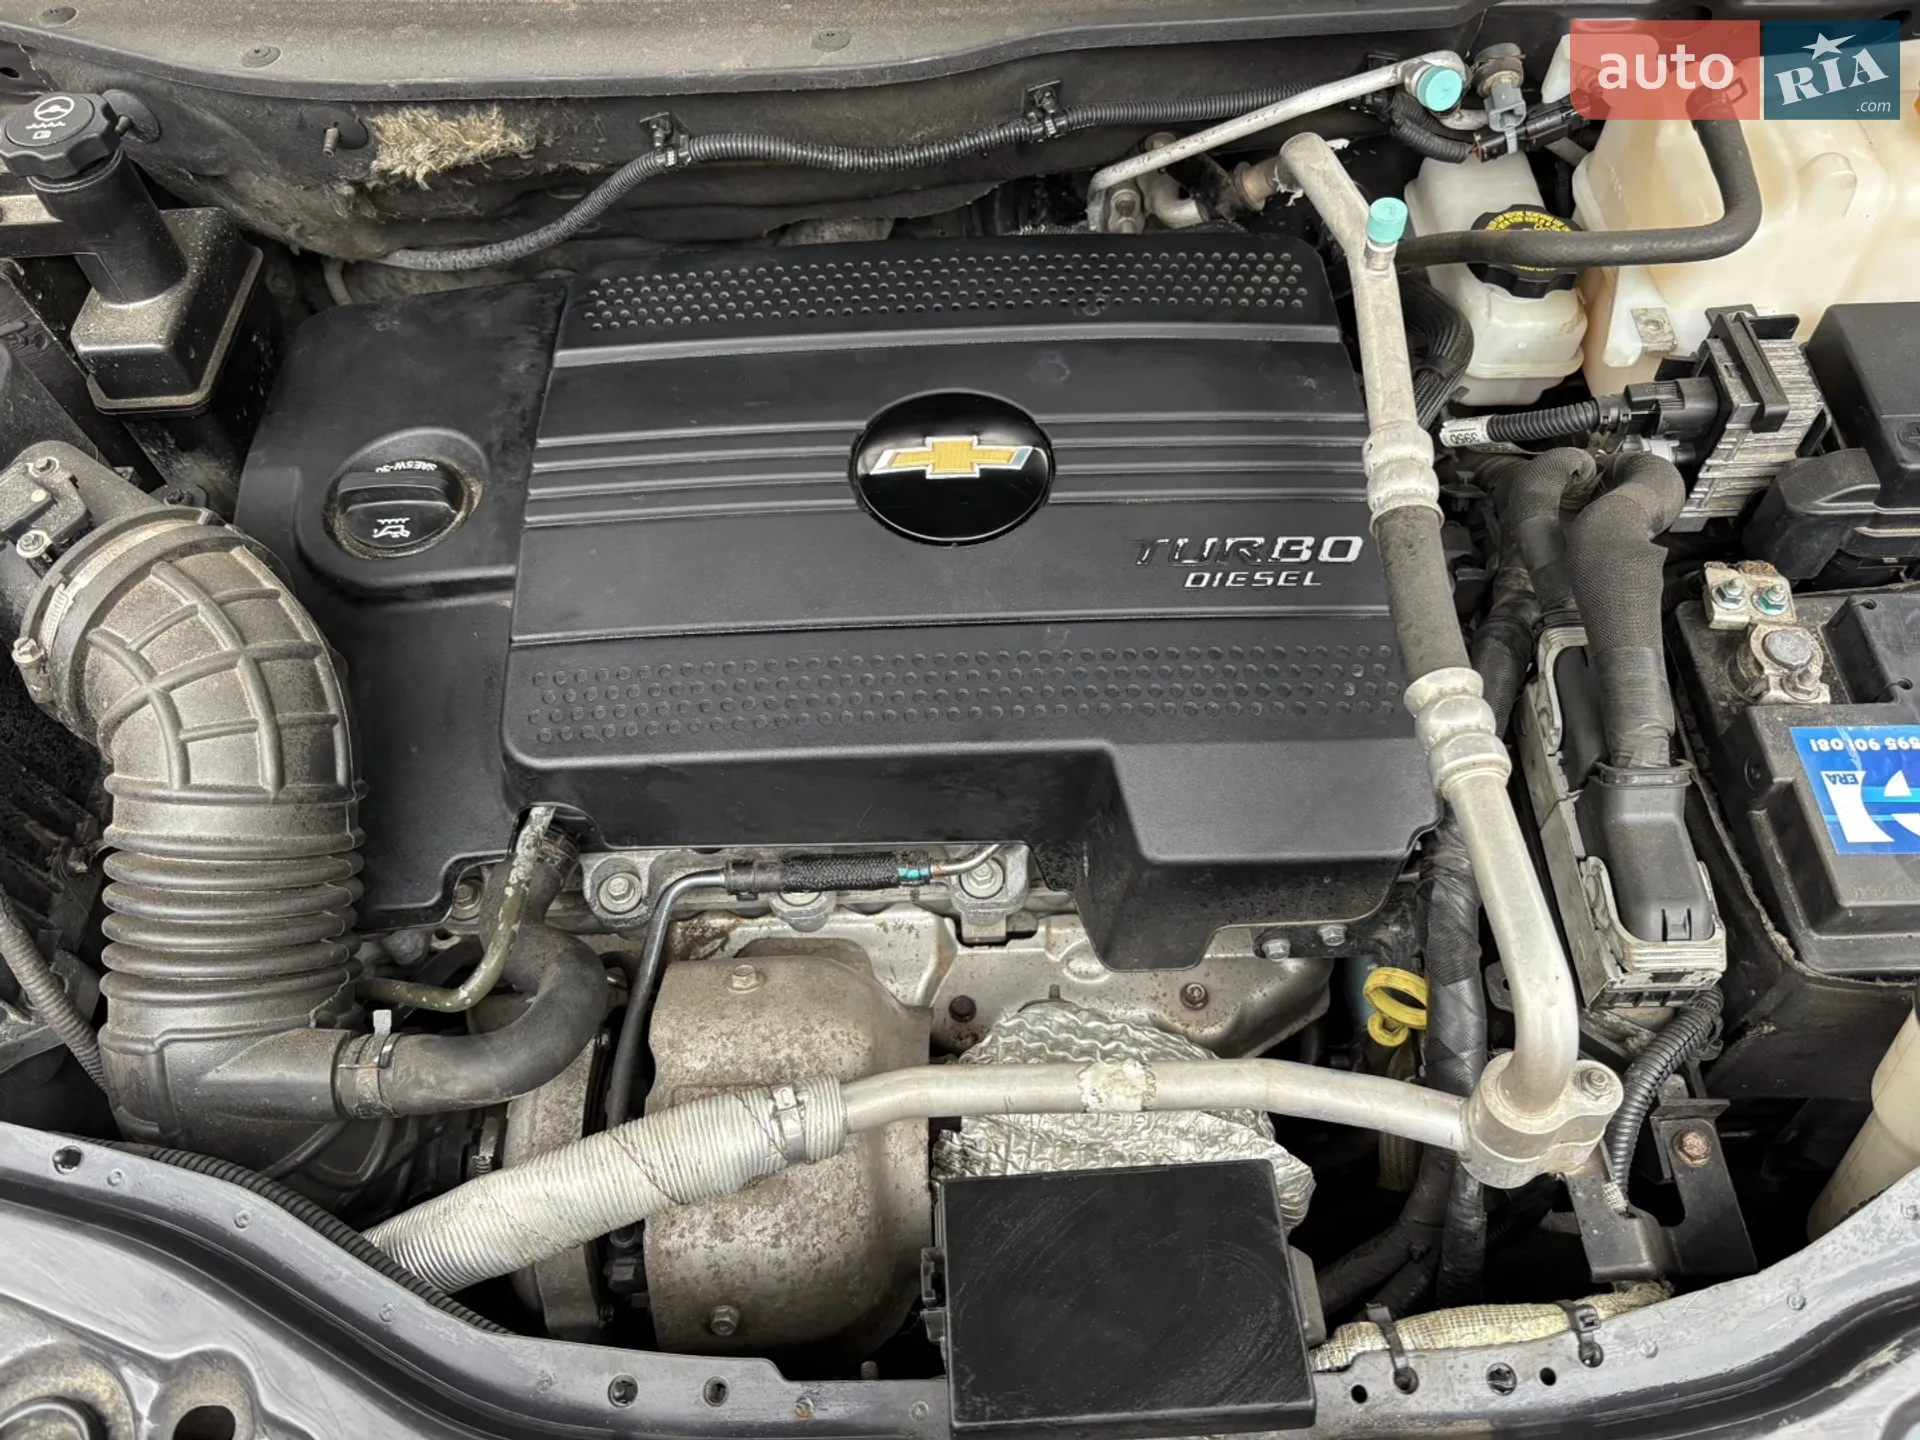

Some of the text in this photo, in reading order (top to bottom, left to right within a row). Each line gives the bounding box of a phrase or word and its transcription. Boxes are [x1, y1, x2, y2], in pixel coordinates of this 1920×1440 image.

[1132, 536, 1364, 565] TURBO
[1184, 571, 1322, 589] DIESEL
[1809, 738, 1845, 752] 081
[1824, 773, 1860, 786] ERA
